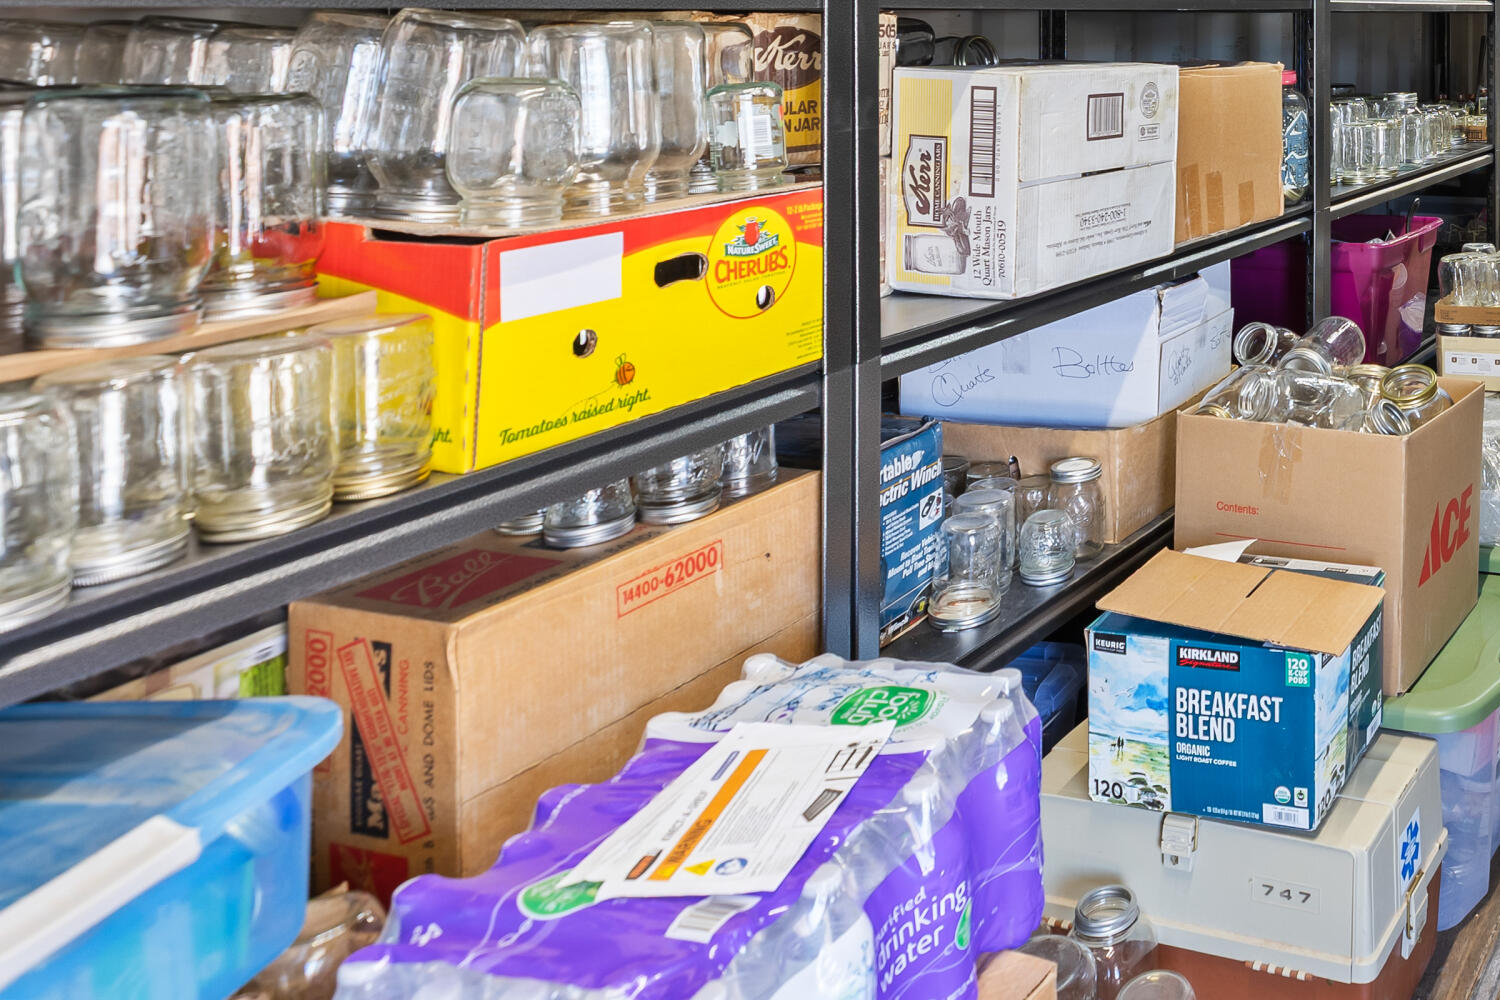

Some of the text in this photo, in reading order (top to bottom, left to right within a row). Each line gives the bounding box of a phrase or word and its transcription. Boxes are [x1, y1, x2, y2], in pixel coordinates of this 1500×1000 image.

[755, 34, 821, 72] Kerr
[909, 149, 932, 216] Kerr
[933, 143, 942, 221] HOME CANNING JARS
[714, 245, 789, 284] CHERUBS
[972, 210, 982, 280] 12 Wide Mouth
[982, 205, 993, 287] Quart Mason Jars
[996, 219, 1008, 279] 70610-00519
[931, 364, 997, 408] Quarts
[499, 388, 652, 447] Tomatoes raised right.
[911, 458, 942, 492] Winch
[1215, 500, 1260, 517] Contents:
[1417, 483, 1475, 588] ACE
[622, 546, 719, 606] 14400-62000
[1095, 638, 1126, 650] KEURIG
[1178, 647, 1239, 664] KIRKLAND
[1352, 611, 1382, 667] BREAKFAST
[1287, 657, 1308, 670] 120
[1288, 676, 1308, 685] PODS
[1351, 652, 1370, 693] BLEND
[397, 659, 410, 736] CANNING
[1175, 686, 1284, 723] BREAKFAST
[422, 661, 434, 790] AND DOME LIDS
[1175, 712, 1236, 743] BLEND
[1175, 742, 1211, 757] ORGANIC
[1175, 754, 1237, 768] LIGHT ROAST COFFEE
[1093, 779, 1123, 800] 120
[878, 880, 967, 971] drinking
[880, 924, 944, 993] water
